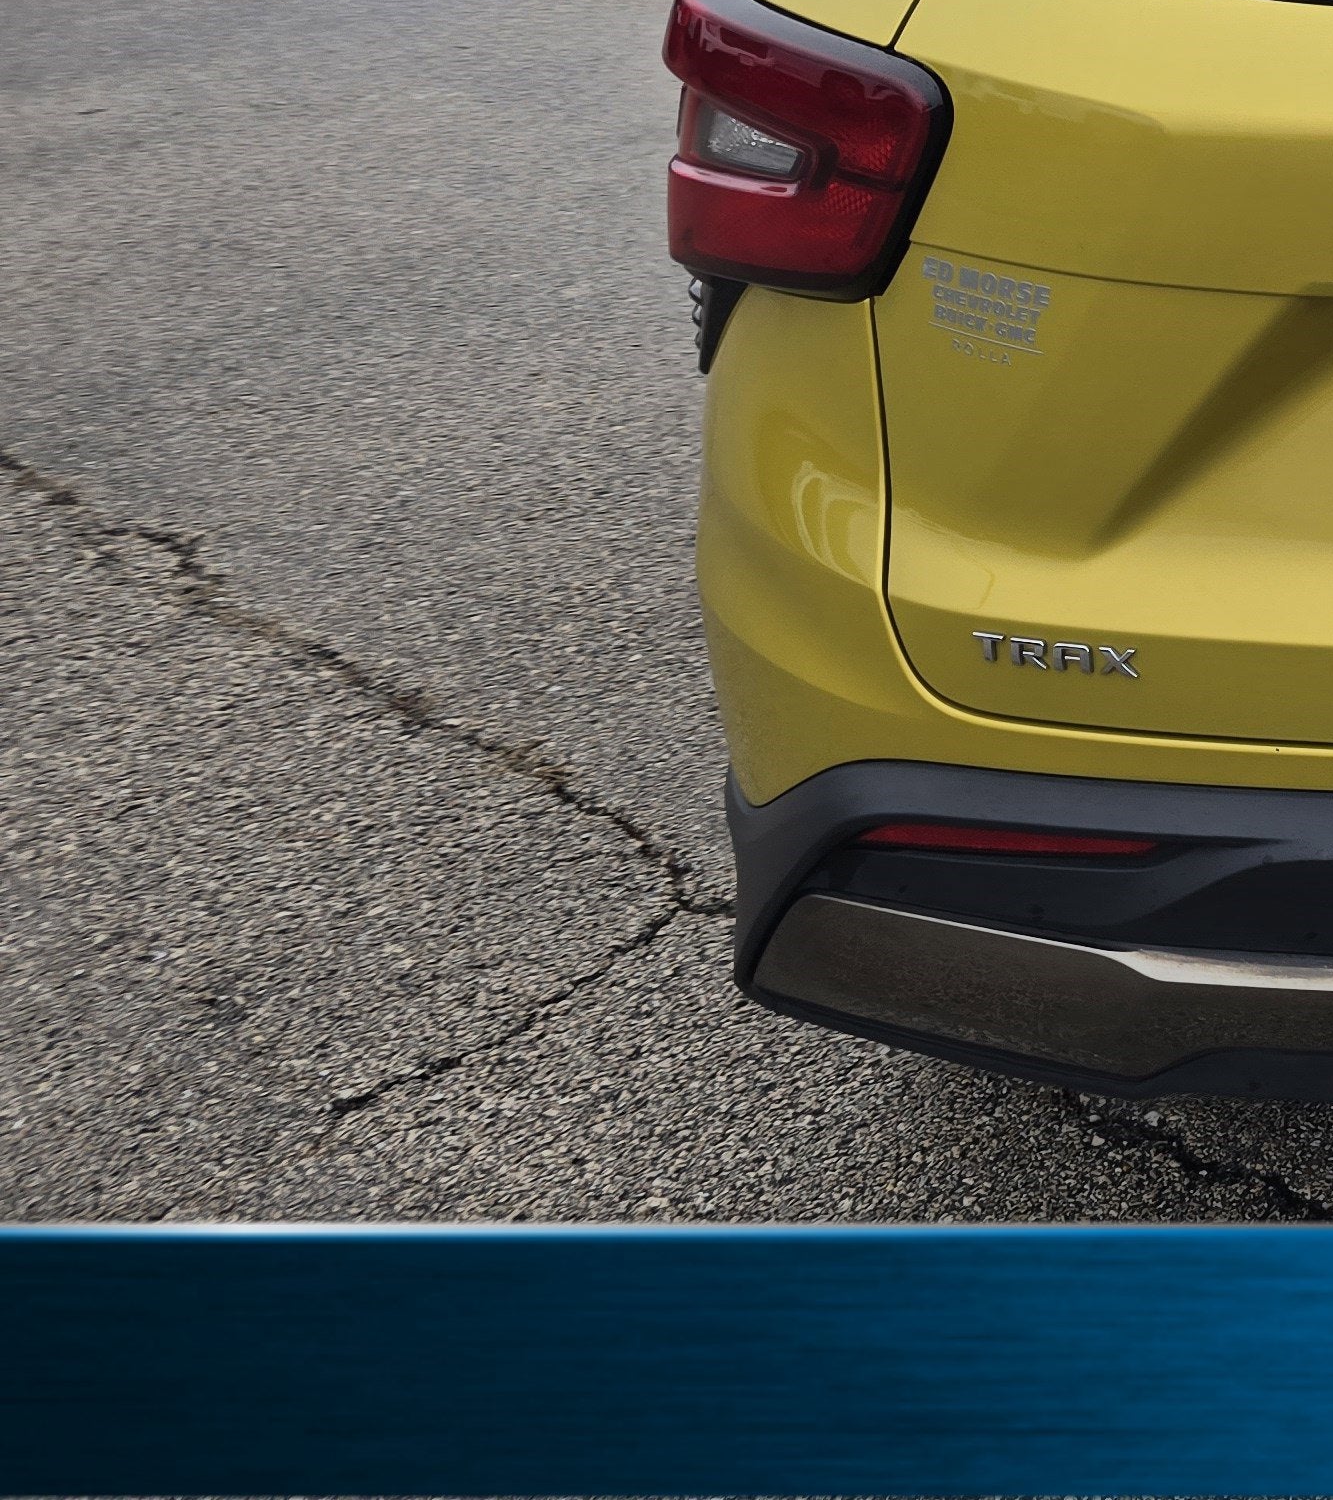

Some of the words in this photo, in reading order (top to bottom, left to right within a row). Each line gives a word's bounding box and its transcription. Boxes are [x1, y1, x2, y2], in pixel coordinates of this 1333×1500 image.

[922, 255, 952, 283] ED
[959, 265, 1050, 308] MORSE
[933, 284, 1040, 325] CHEVROLET
[972, 631, 1139, 678] TRAX
